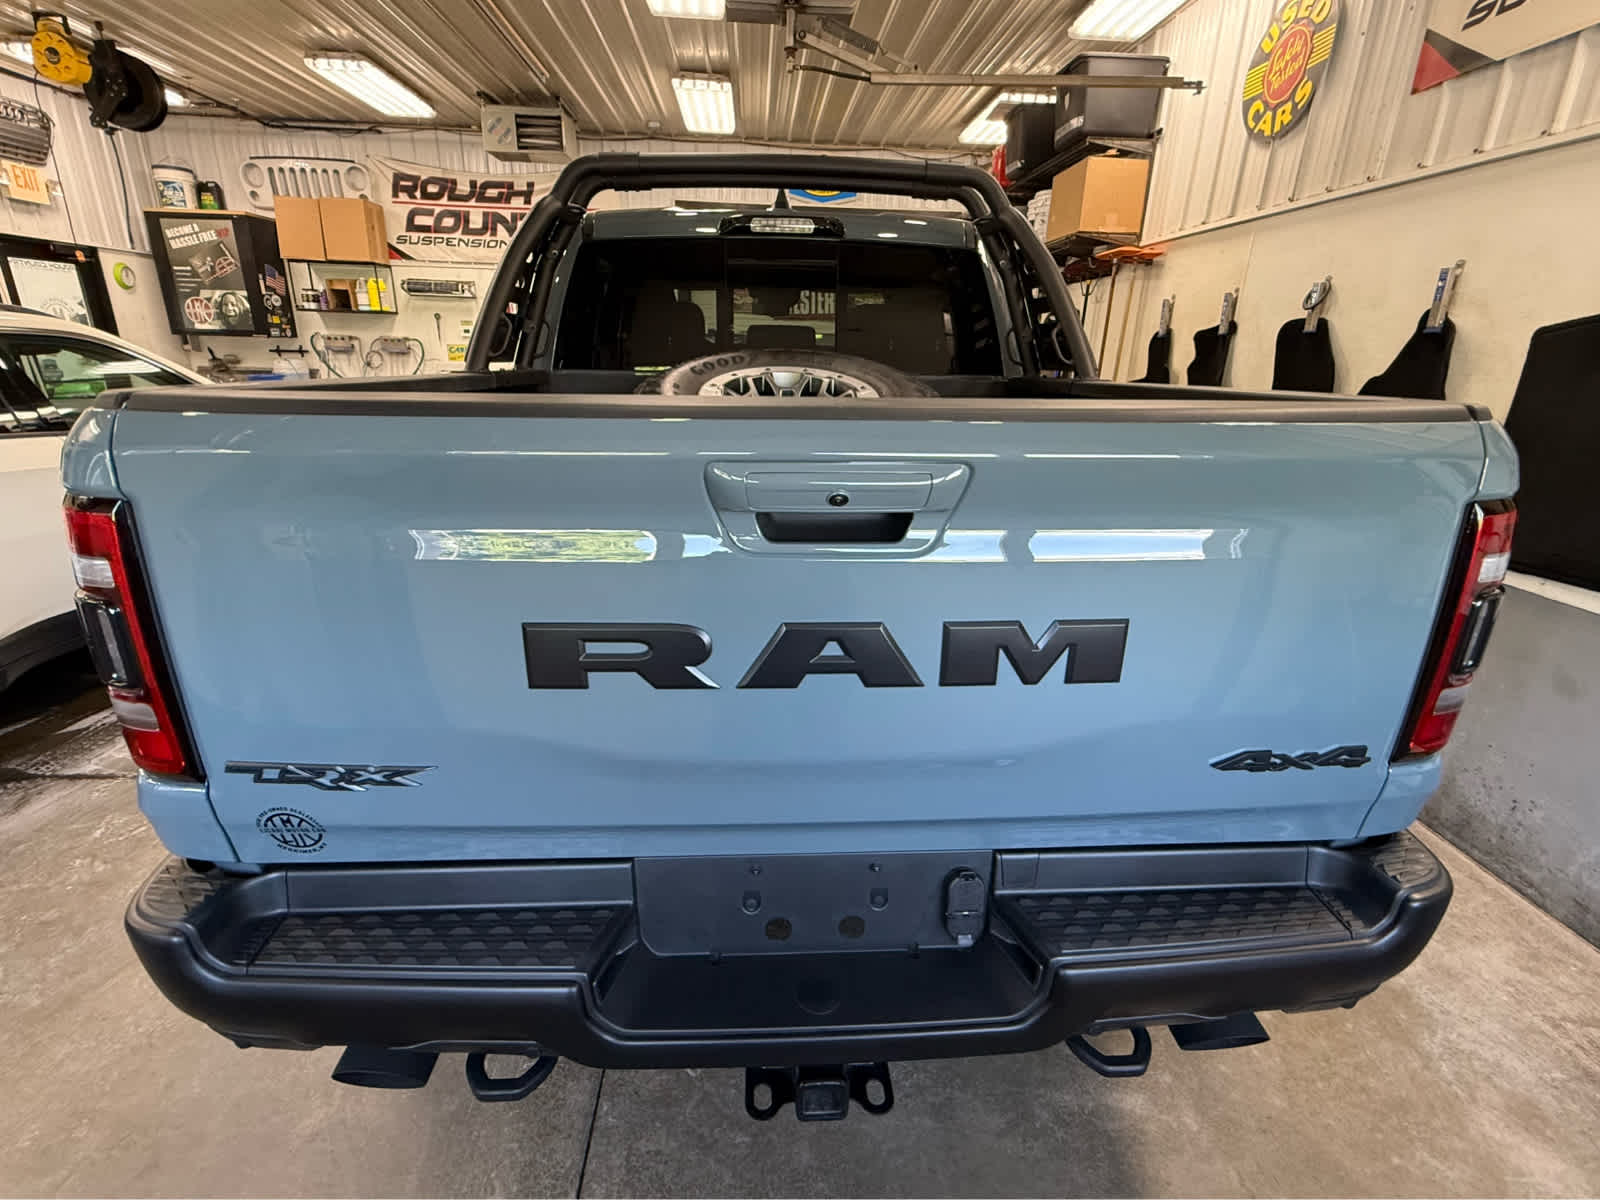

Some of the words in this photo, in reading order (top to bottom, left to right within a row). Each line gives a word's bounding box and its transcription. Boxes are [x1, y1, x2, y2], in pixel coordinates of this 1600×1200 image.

[1261, 0, 1332, 54] USED
[1247, 78, 1313, 136] CARS
[11, 165, 40, 192] EXIT
[392, 172, 535, 205] ROUGH
[522, 619, 1130, 690] RAM
[224, 760, 438, 792] TRX
